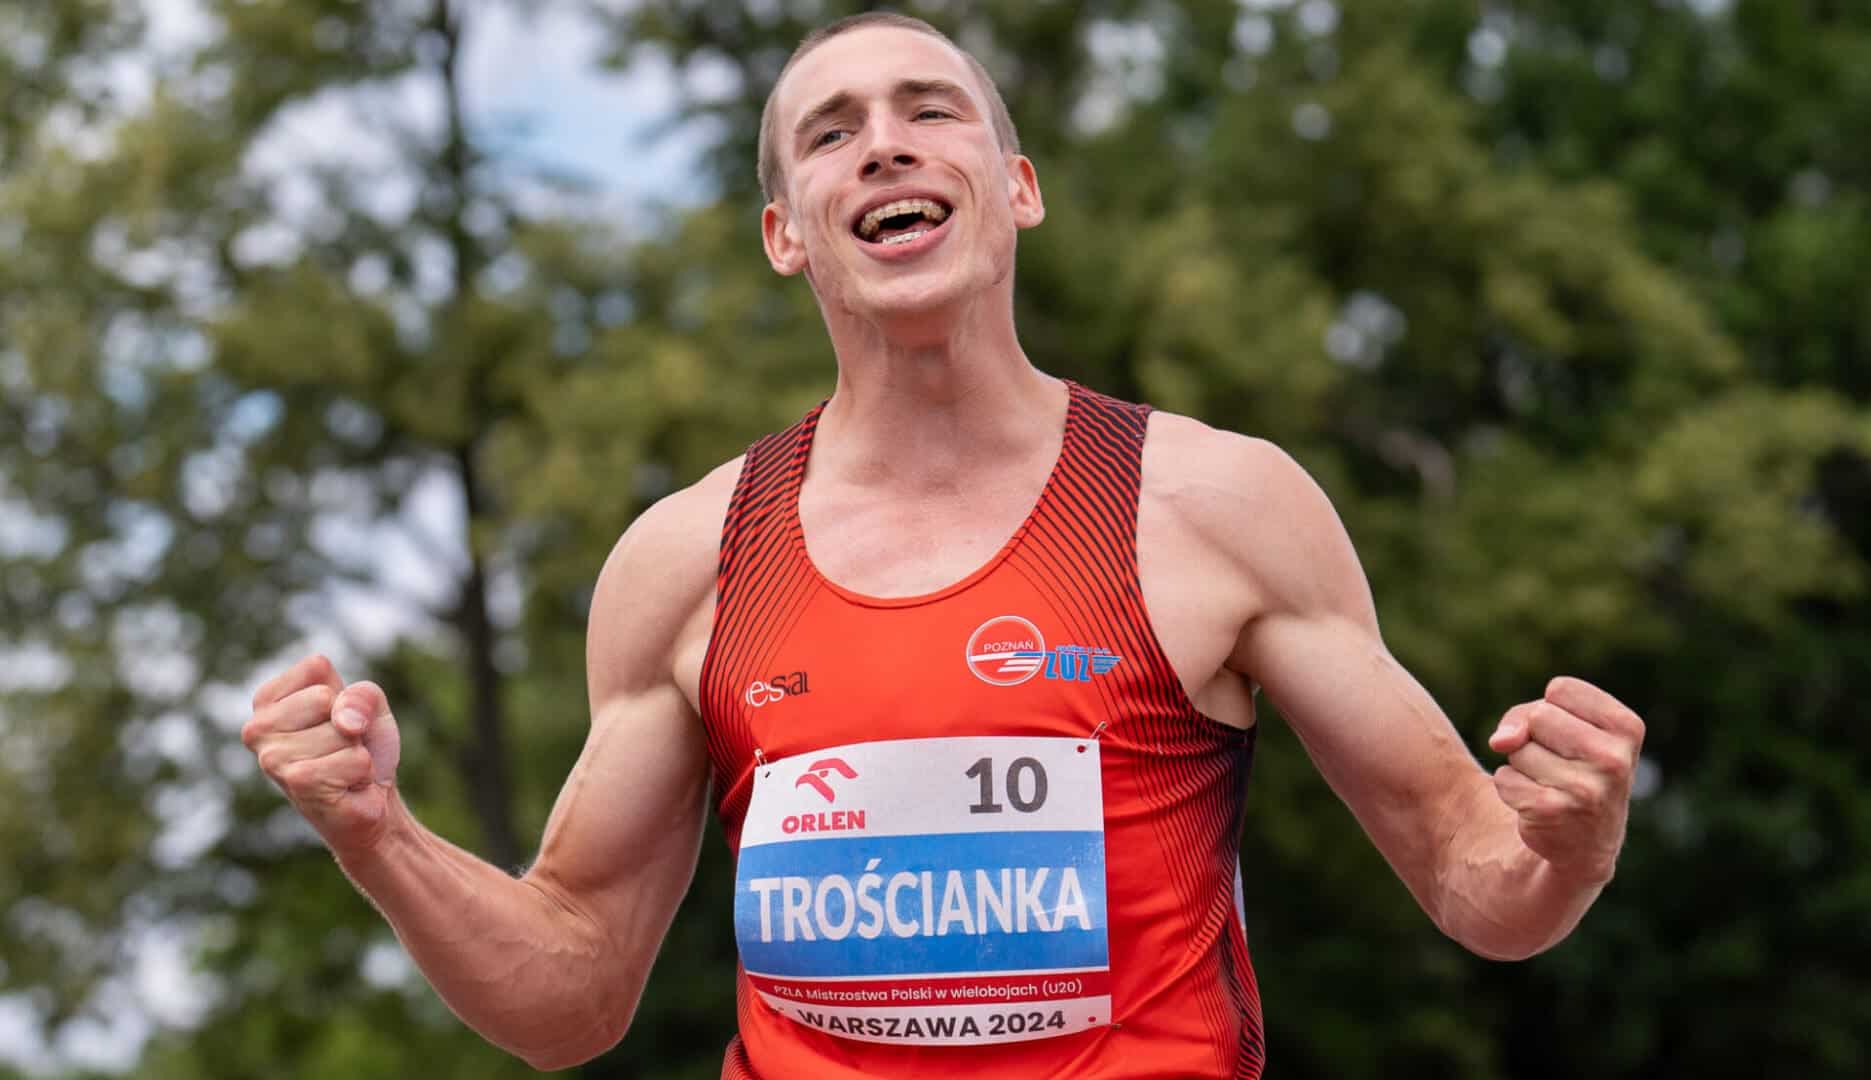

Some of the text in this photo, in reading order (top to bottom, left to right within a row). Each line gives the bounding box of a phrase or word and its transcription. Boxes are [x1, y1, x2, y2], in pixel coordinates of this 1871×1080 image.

[984, 639, 1034, 653] POZNAŃ
[1044, 652, 1092, 682] ZUZ
[965, 757, 1048, 814] 10
[781, 810, 866, 834] ORLEN
[750, 858, 1092, 943] TROŚCIANKA
[774, 978, 1083, 1001] PZLA Mistrzostwa Polski w wielobojach (U20)
[797, 1009, 1066, 1039] WARSZAWA 2024
